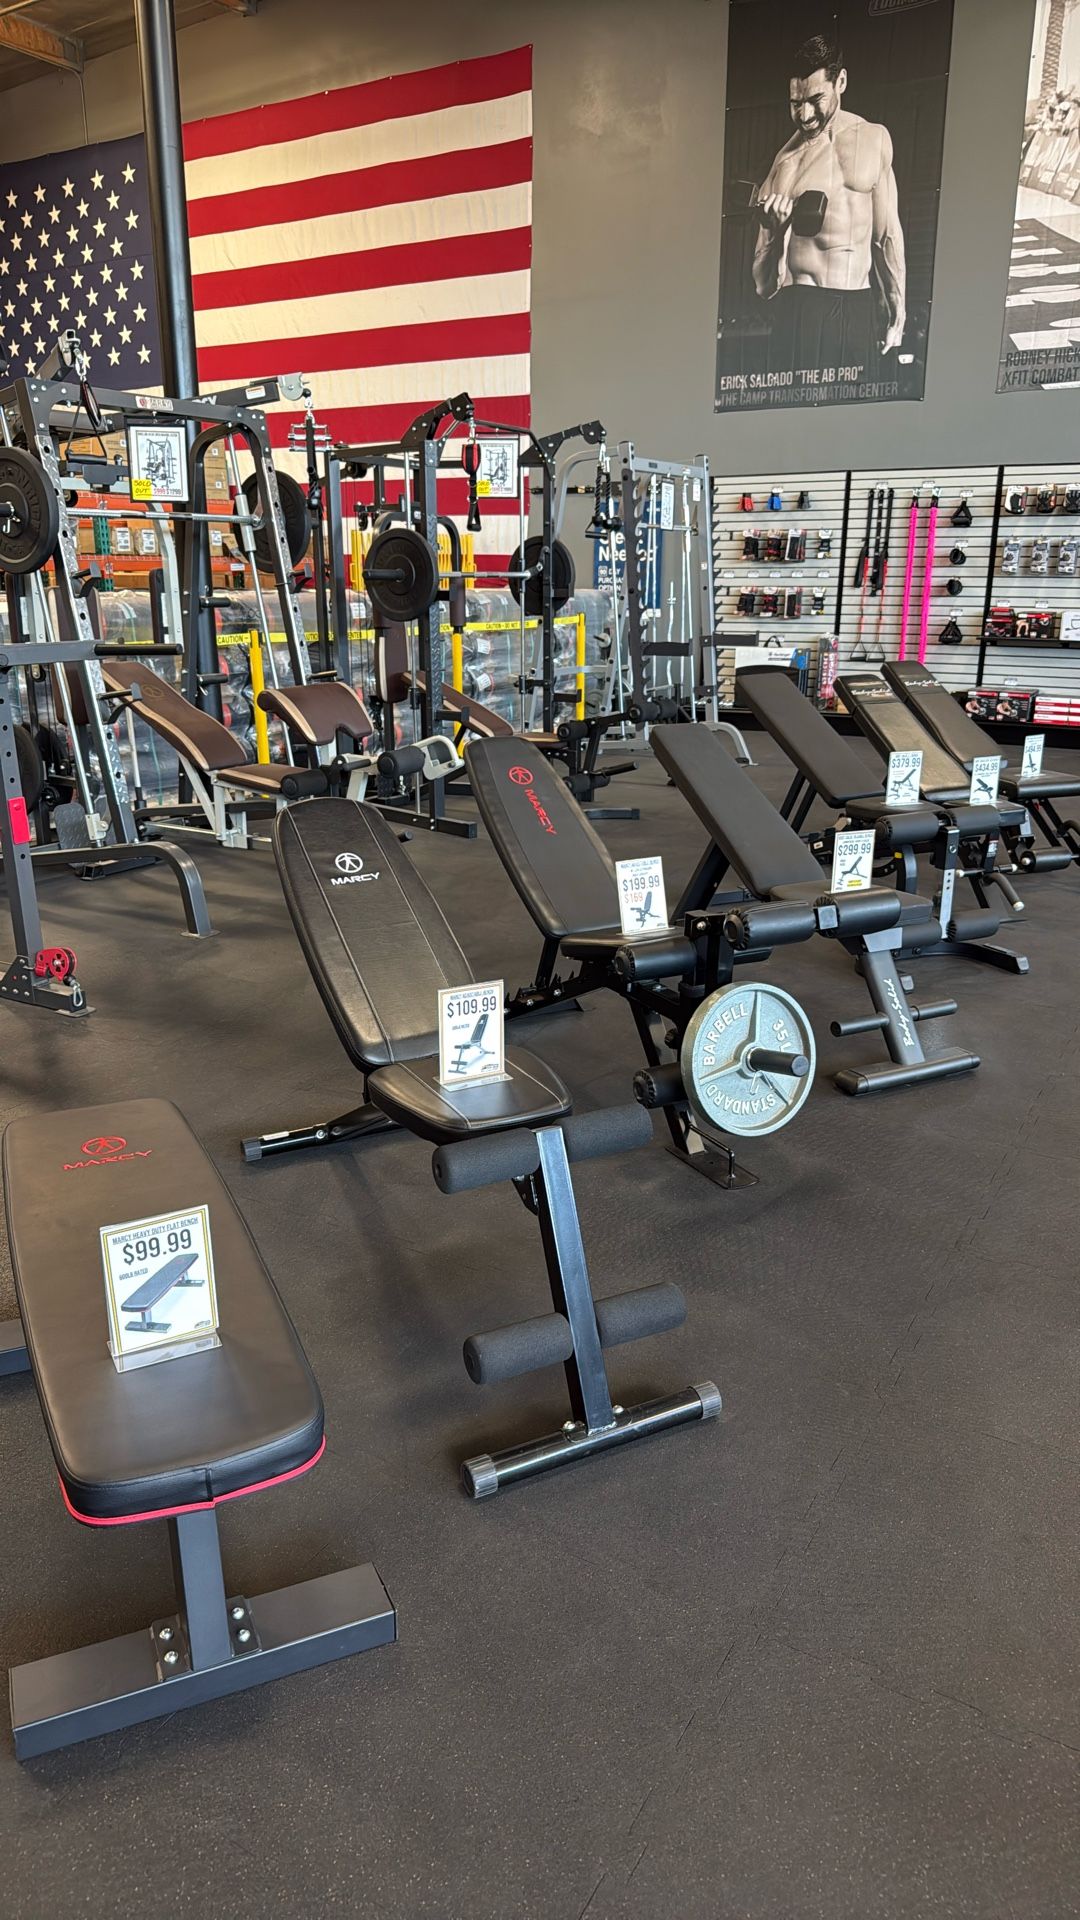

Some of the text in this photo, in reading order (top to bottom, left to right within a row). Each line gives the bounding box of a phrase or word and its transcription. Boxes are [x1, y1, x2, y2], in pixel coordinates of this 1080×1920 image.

[1006, 350, 1051, 367] RODNEY
[720, 366, 864, 390] ERICK SALGADO "THE AB PRO"
[1004, 367, 1080, 385] XFIT COMBAT
[720, 381, 898, 407] THE CAMP TRANSFORMATION CENTER
[217, 635, 244, 645] CAUTION
[891, 757, 921, 769] $379.99
[524, 788, 557, 834] MARCY
[838, 843, 871, 856] $299.99
[330, 872, 380, 886] MARCY
[622, 875, 660, 892] $199.99
[447, 995, 497, 1018] $109.99
[703, 1003, 776, 1115] STANDARD BARBELL
[63, 1149, 153, 1171] MARCY
[112, 1217, 199, 1245] MARCY HEAVY DUTY FLAT BENCH
[122, 1228, 192, 1266] $99.99
